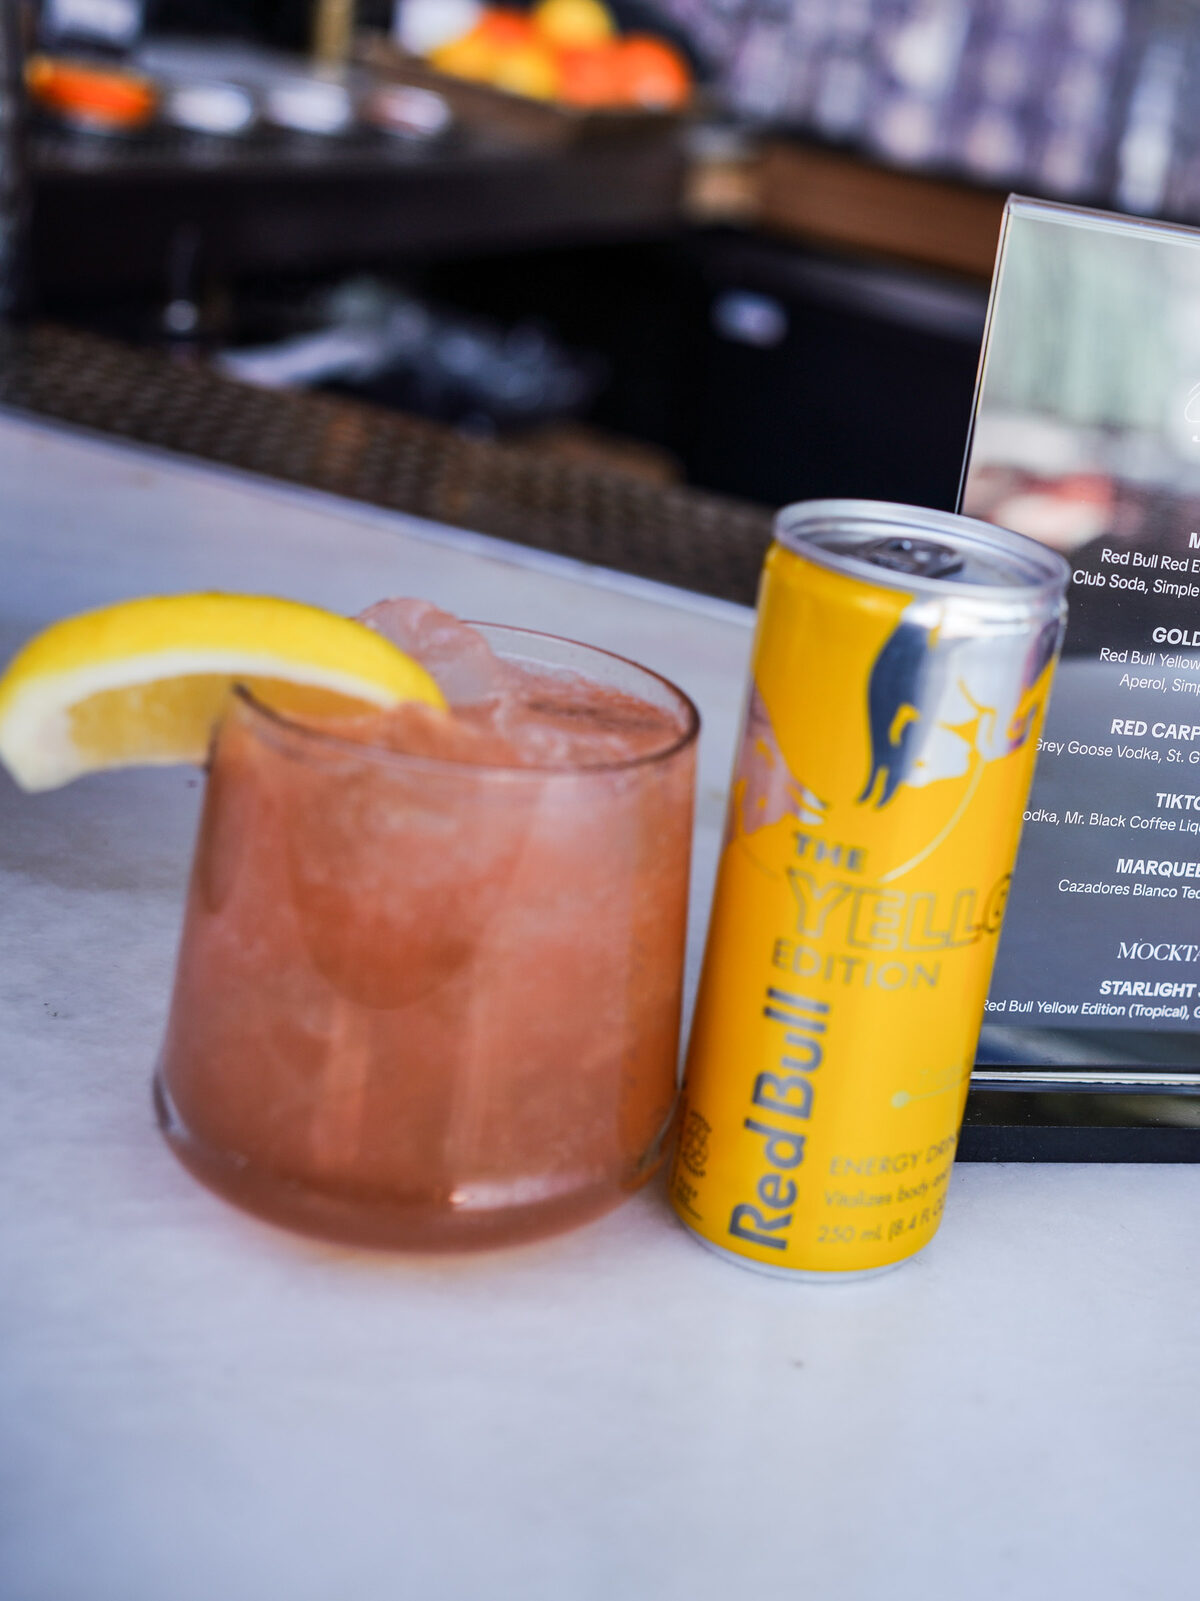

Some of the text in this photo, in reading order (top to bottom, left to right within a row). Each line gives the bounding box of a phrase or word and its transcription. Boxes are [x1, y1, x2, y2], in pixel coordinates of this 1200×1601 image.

[1101, 548, 1130, 565] Red
[1132, 552, 1158, 568] Bull
[1160, 555, 1189, 572] Red
[1072, 569, 1106, 587] Club
[1108, 574, 1149, 595] Soda,
[1152, 579, 1200, 598] Simple
[1099, 647, 1128, 663] Red
[1130, 650, 1156, 666] Bull
[1119, 673, 1168, 694] Aperol,
[1110, 718, 1148, 737] RED
[1067, 740, 1113, 757] Goose
[1116, 745, 1163, 764] Vodka,
[1166, 748, 1185, 763] St.
[1022, 808, 1061, 826] odka,
[1064, 810, 1085, 825] Mr.
[1089, 812, 1127, 828] Black
[1129, 815, 1177, 831] Coffee
[790, 830, 868, 873] THE
[1057, 878, 1131, 896] Cazadores
[1132, 883, 1178, 899] Blanco
[787, 868, 1012, 953] YELLO
[770, 937, 942, 992] EDITION
[1099, 980, 1198, 998] STARLIGHT
[1008, 1000, 1034, 1013] Bull
[1036, 1001, 1079, 1015] Yellow
[1080, 1002, 1126, 1016] Edition
[1128, 1003, 1191, 1020] (Tropical),
[829, 1150, 924, 1177] ENERGY
[817, 1225, 856, 1243] 250
